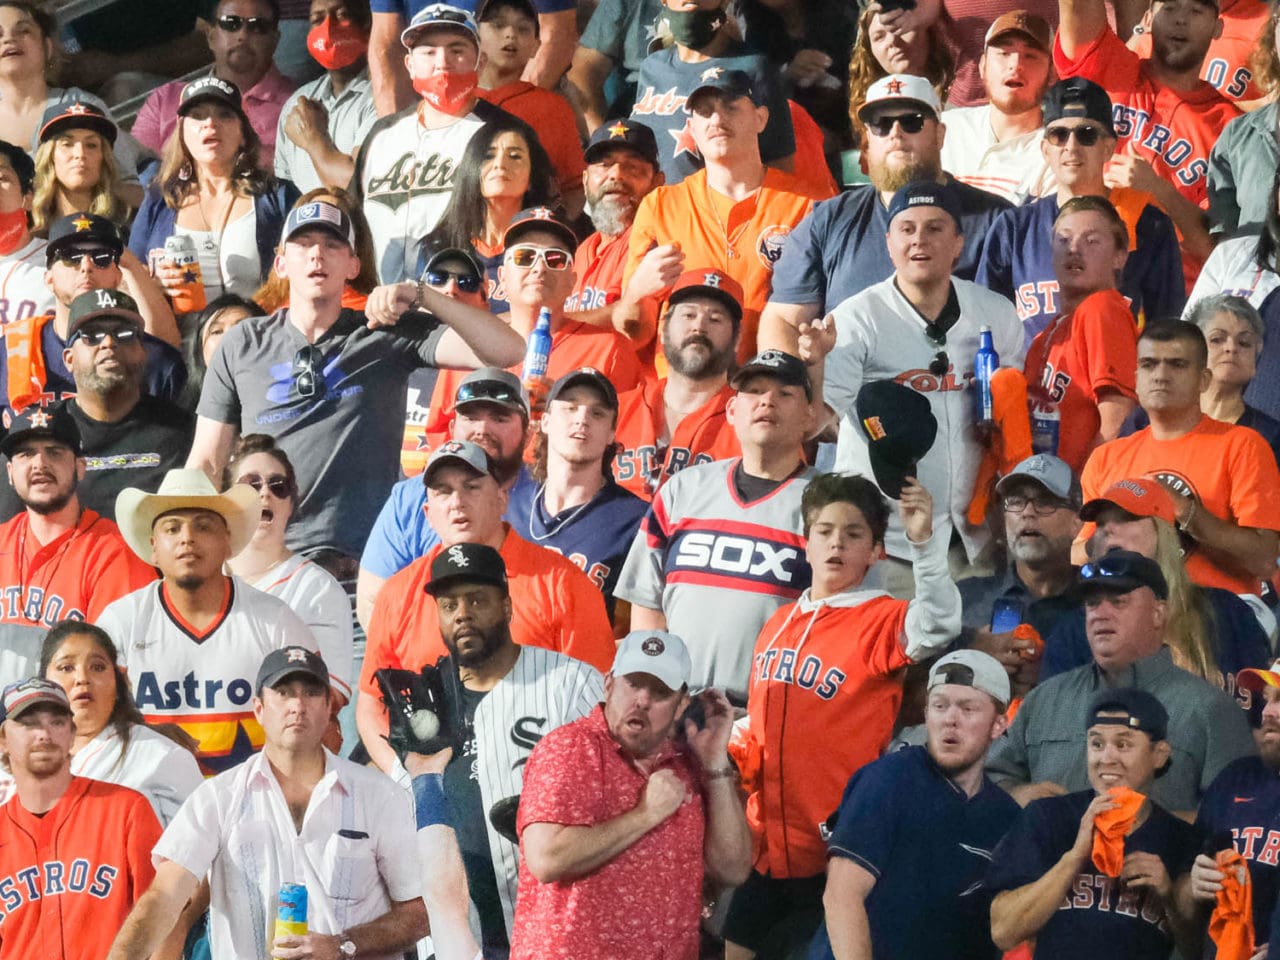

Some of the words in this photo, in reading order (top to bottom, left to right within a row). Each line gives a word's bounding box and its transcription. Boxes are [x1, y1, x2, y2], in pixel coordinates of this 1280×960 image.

[187, 76, 234, 95] ASTROS
[908, 195, 935, 205] ASTROS
[95, 289, 117, 308] LA
[676, 533, 798, 582] SOX
[136, 671, 252, 711] Astro
